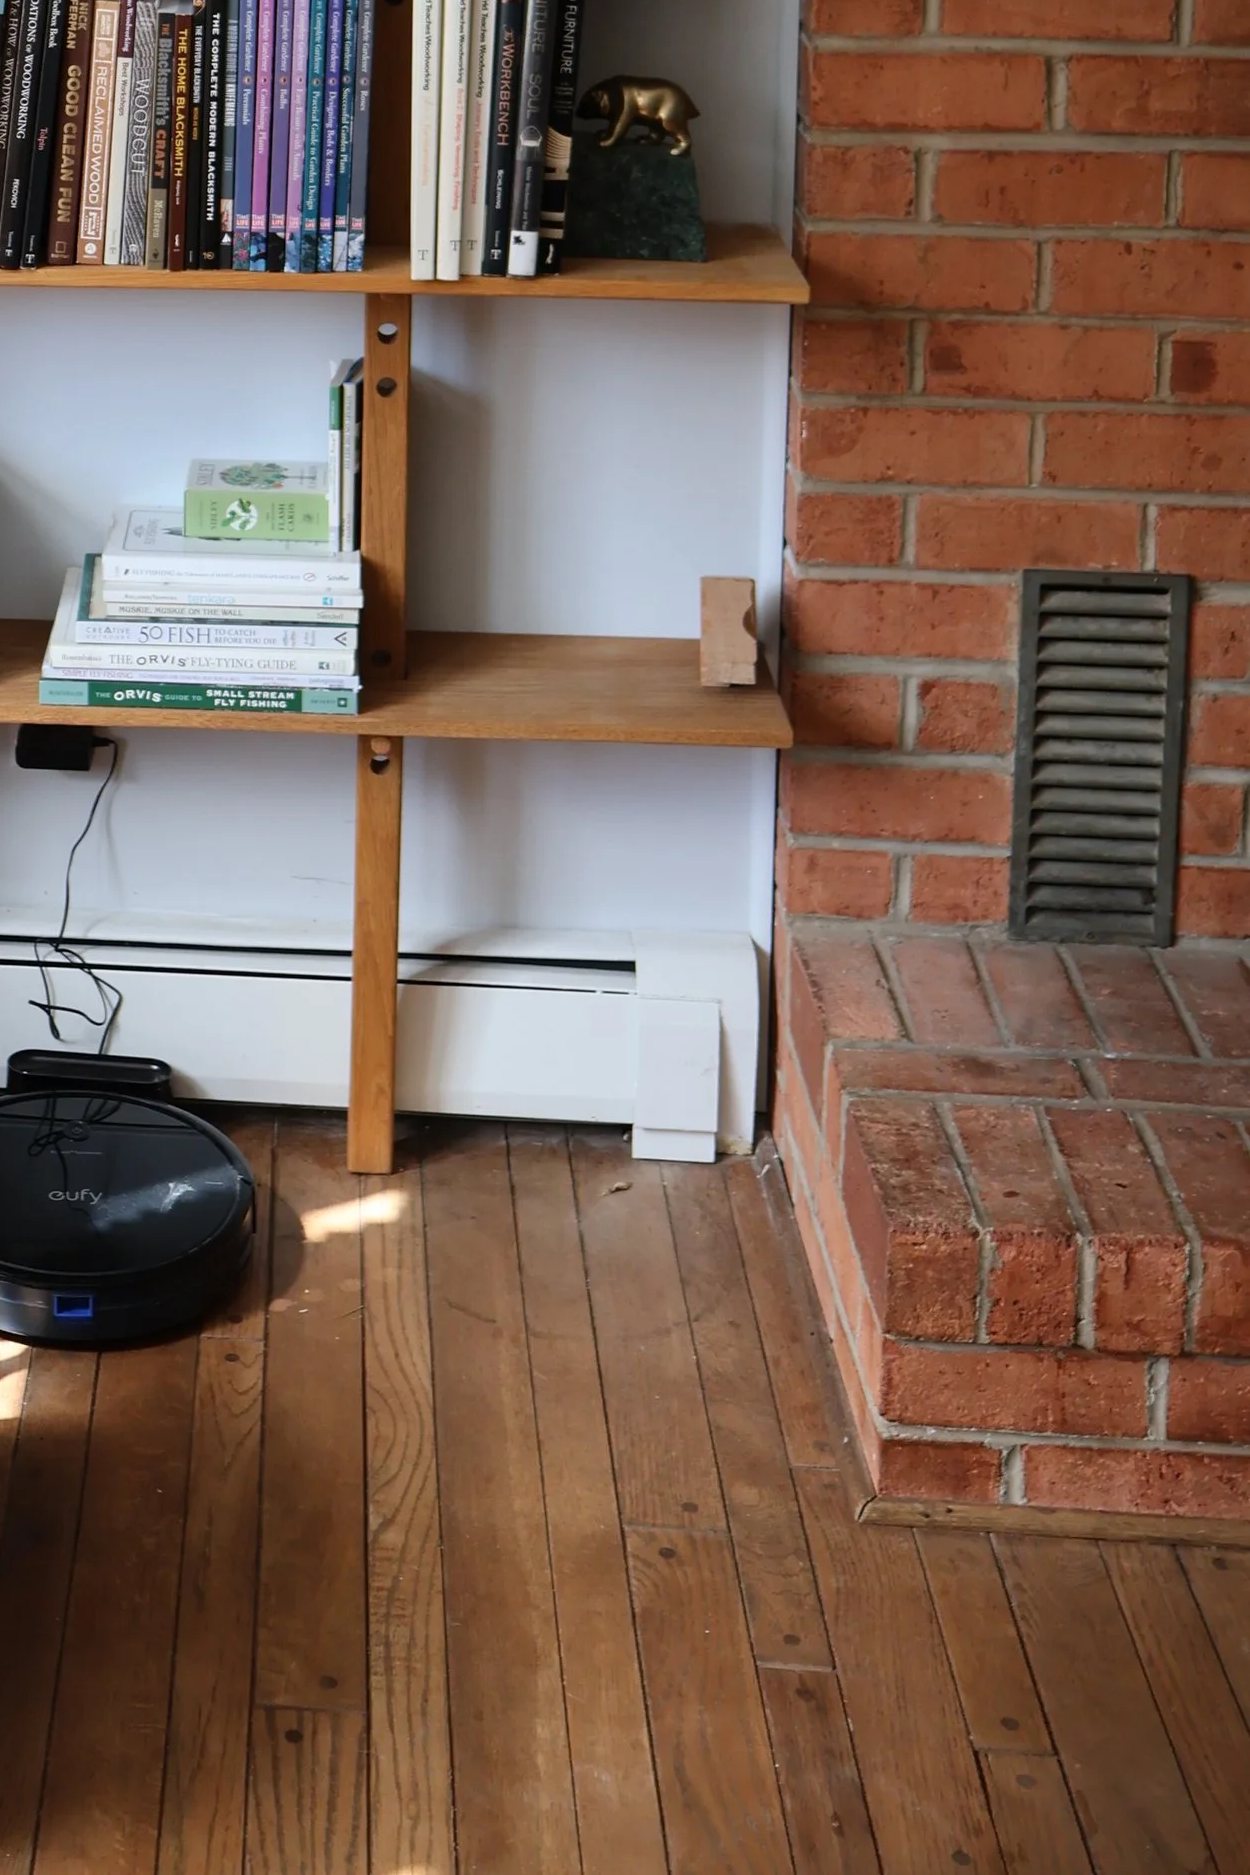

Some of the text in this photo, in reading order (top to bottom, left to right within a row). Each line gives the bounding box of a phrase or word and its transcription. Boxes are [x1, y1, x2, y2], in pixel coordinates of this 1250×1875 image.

[77, 2, 89, 31] NICK
[195, 25, 203, 36] THE
[344, 9, 353, 40] Complete
[424, 5, 432, 34] Teaches
[7, 18, 19, 47] HOW
[48, 29, 58, 49] Book
[177, 29, 188, 54] THE
[559, 5, 578, 75] FURNITURE
[193, 37, 203, 67] EVERYDAY
[343, 40, 352, 71] Gardener
[422, 34, 432, 91] Woodworking
[155, 38, 172, 126] Blacksmith's
[176, 57, 187, 94] HOME
[192, 67, 202, 103] BLACKSMITH
[15, 53, 35, 140] WOODWORKING
[342, 87, 351, 125] Successful
[497, 43, 516, 147] WORKBENCH
[526, 73, 542, 118] SOUL
[131, 78, 151, 175] WOODCUT
[206, 12, 221, 221] THE COMPLETE MODERN BLACKSMITH
[38, 127, 49, 151] Tolpin
[57, 65, 82, 223] GOOD CLEAN FUN
[87, 66, 108, 204] RECLAIMED WOOD
[174, 96, 187, 178] BLACKSMITH
[340, 125, 349, 153] Garden
[155, 129, 167, 180] CRAFT
[339, 153, 348, 174] Plans
[10, 178, 20, 209] PEKOVICH
[119, 605, 152, 615] MUSKIE,
[155, 606, 185, 615] MUSKIE
[188, 607, 200, 615] ON
[202, 607, 219, 615] THE
[188, 593, 236, 605] tenkara
[85, 626, 130, 635] CREATIVE
[138, 625, 256, 644] 50 FISH TO CATCH
[214, 636, 243, 644] BEFORE
[263, 637, 277, 645] DIE
[109, 654, 297, 670] THE ORVIS FLY-TYING GUIDE
[114, 689, 163, 703] ORVIS
[206, 689, 245, 699] SMALL
[248, 690, 295, 700] STREAM
[213, 698, 288, 709] FLY FISHING
[48, 1188, 103, 1205] eufy
